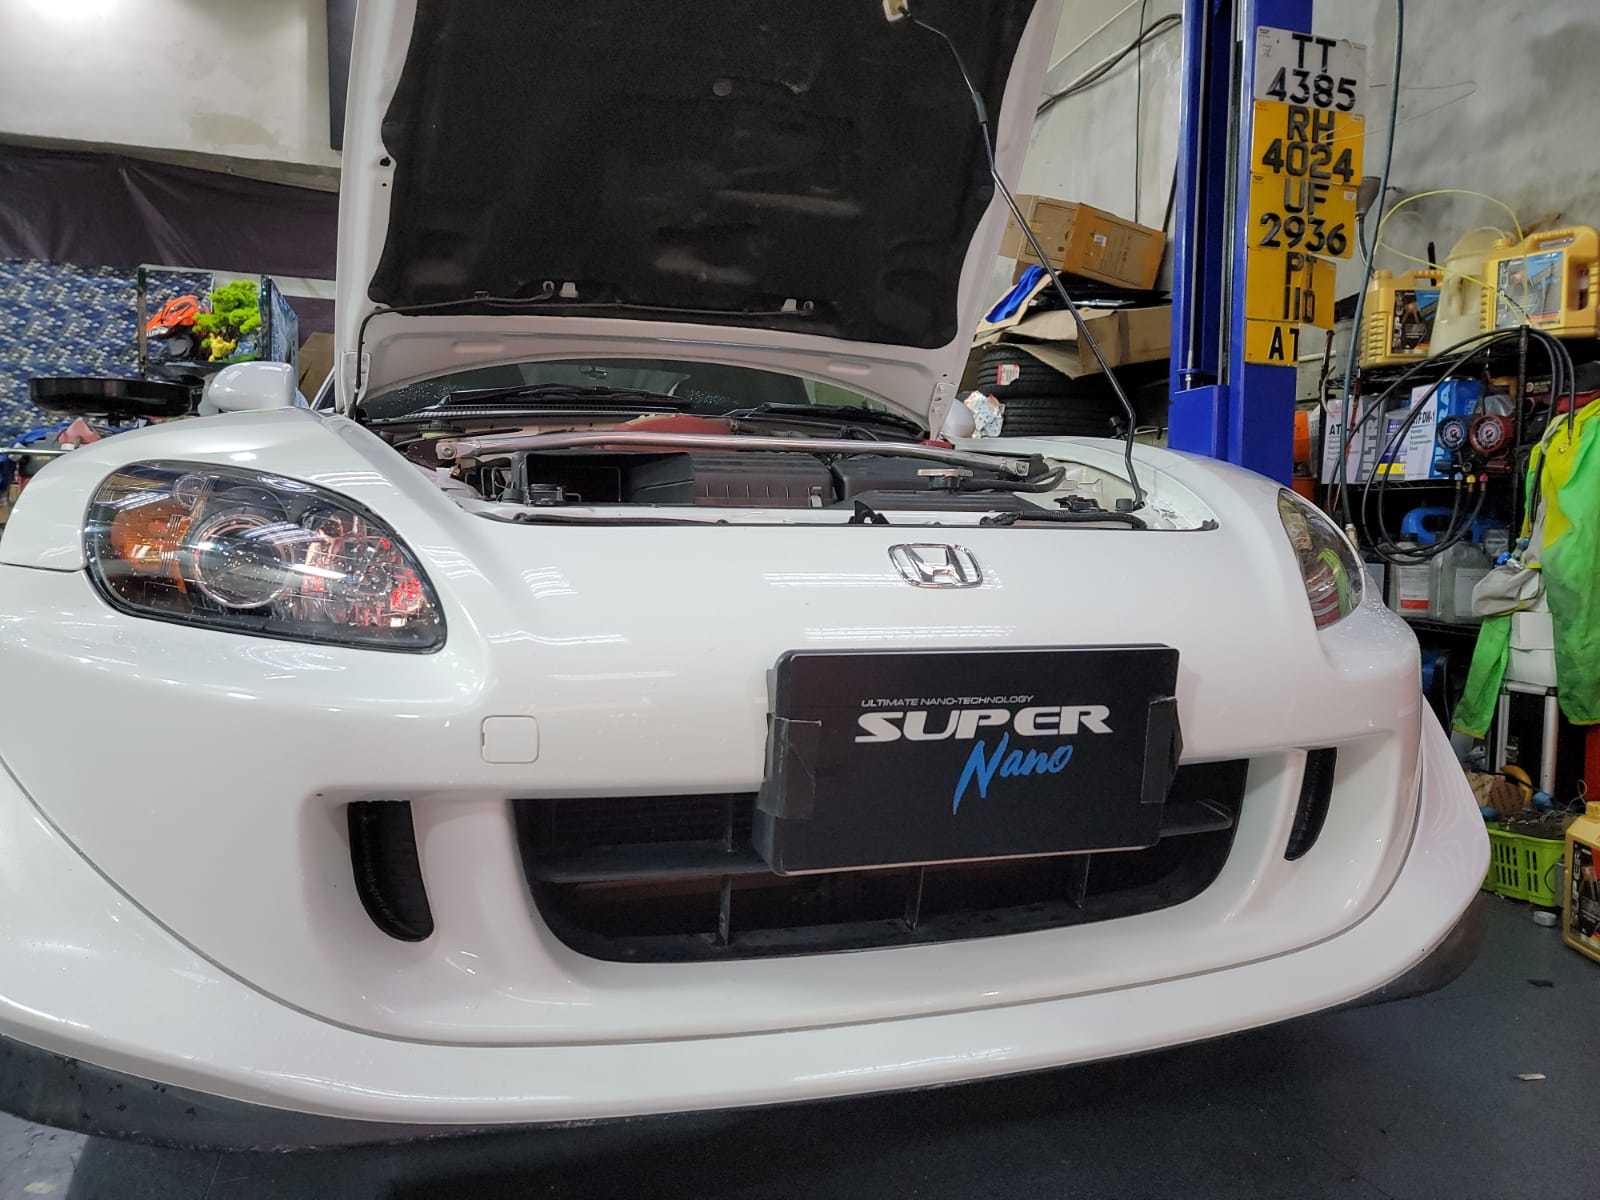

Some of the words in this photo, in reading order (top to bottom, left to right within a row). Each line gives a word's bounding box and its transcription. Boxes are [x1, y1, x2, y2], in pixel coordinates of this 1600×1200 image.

[1292, 33, 1337, 73] TT
[1266, 66, 1357, 111] 4385
[1287, 105, 1335, 146] RH
[1262, 138, 1354, 183] 4024
[1260, 213, 1347, 256] 2936
[861, 698, 918, 708] ULTIMATE
[920, 694, 1034, 706] NANO-TECHNOLOGY
[854, 704, 1114, 743] SUPER
[952, 731, 1074, 816] Nano
